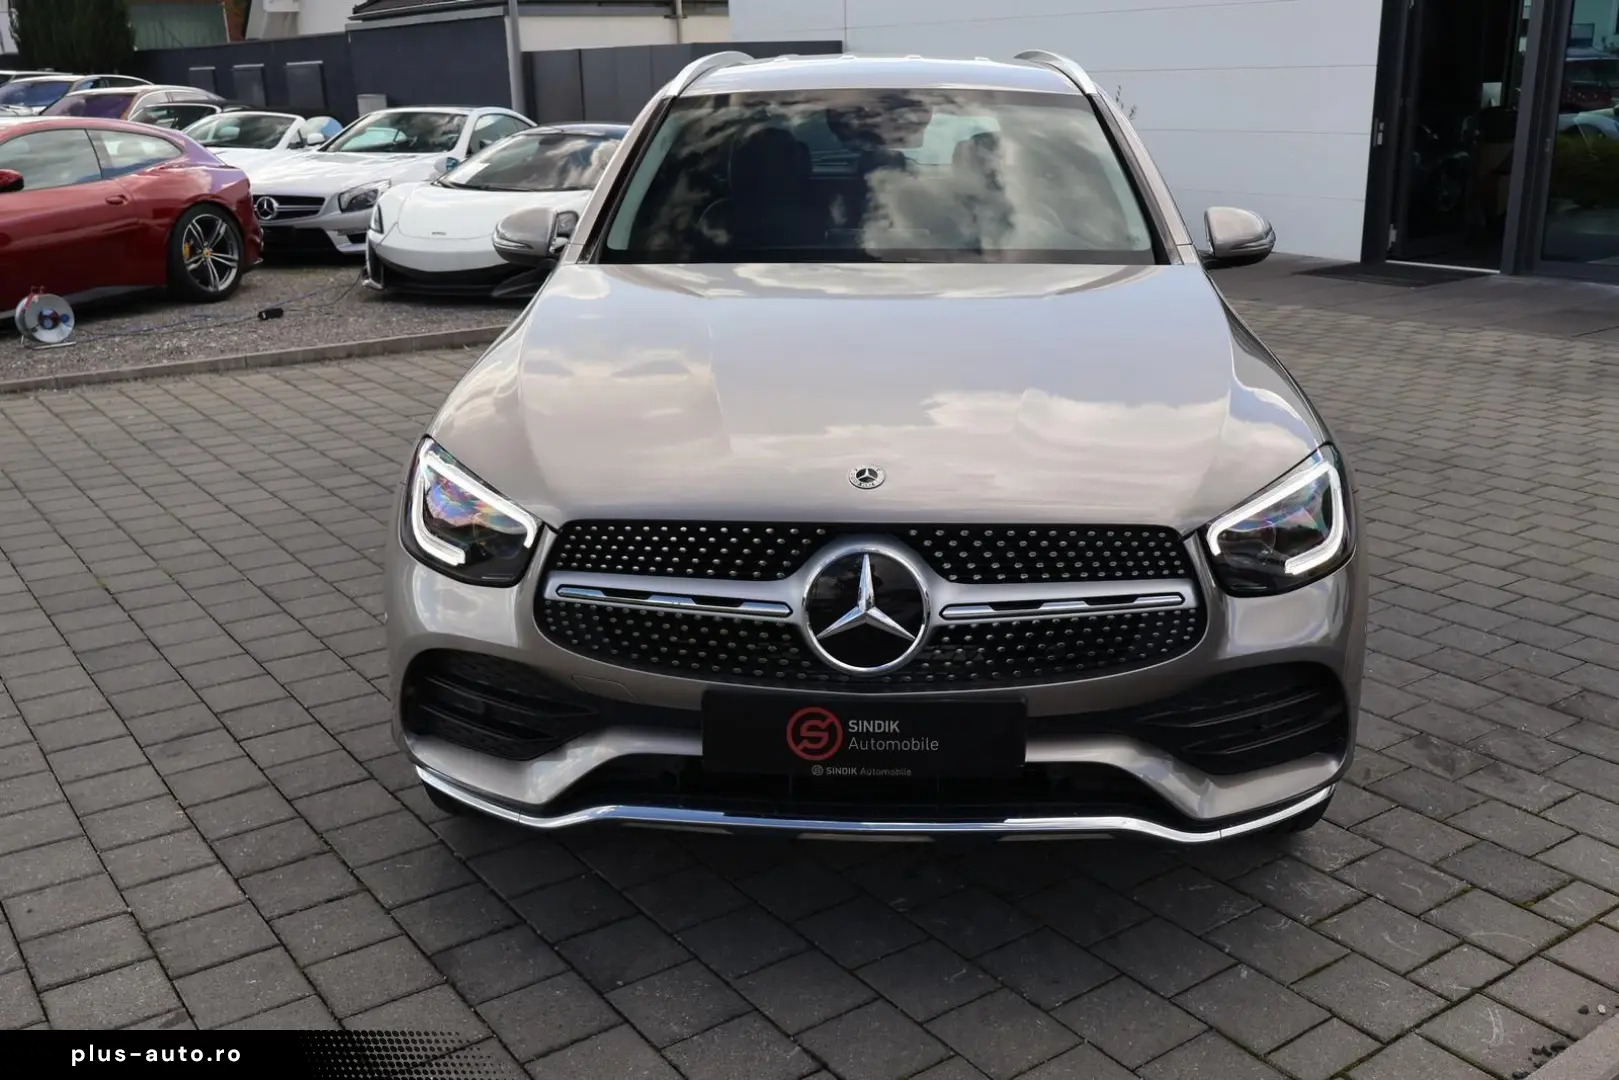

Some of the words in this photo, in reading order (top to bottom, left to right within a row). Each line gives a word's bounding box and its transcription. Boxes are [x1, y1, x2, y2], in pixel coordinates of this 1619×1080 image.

[848, 719, 900, 733] SINDIK
[848, 736, 939, 751] Automobile
[826, 767, 857, 775] SINDIK
[860, 767, 912, 776] Automobile
